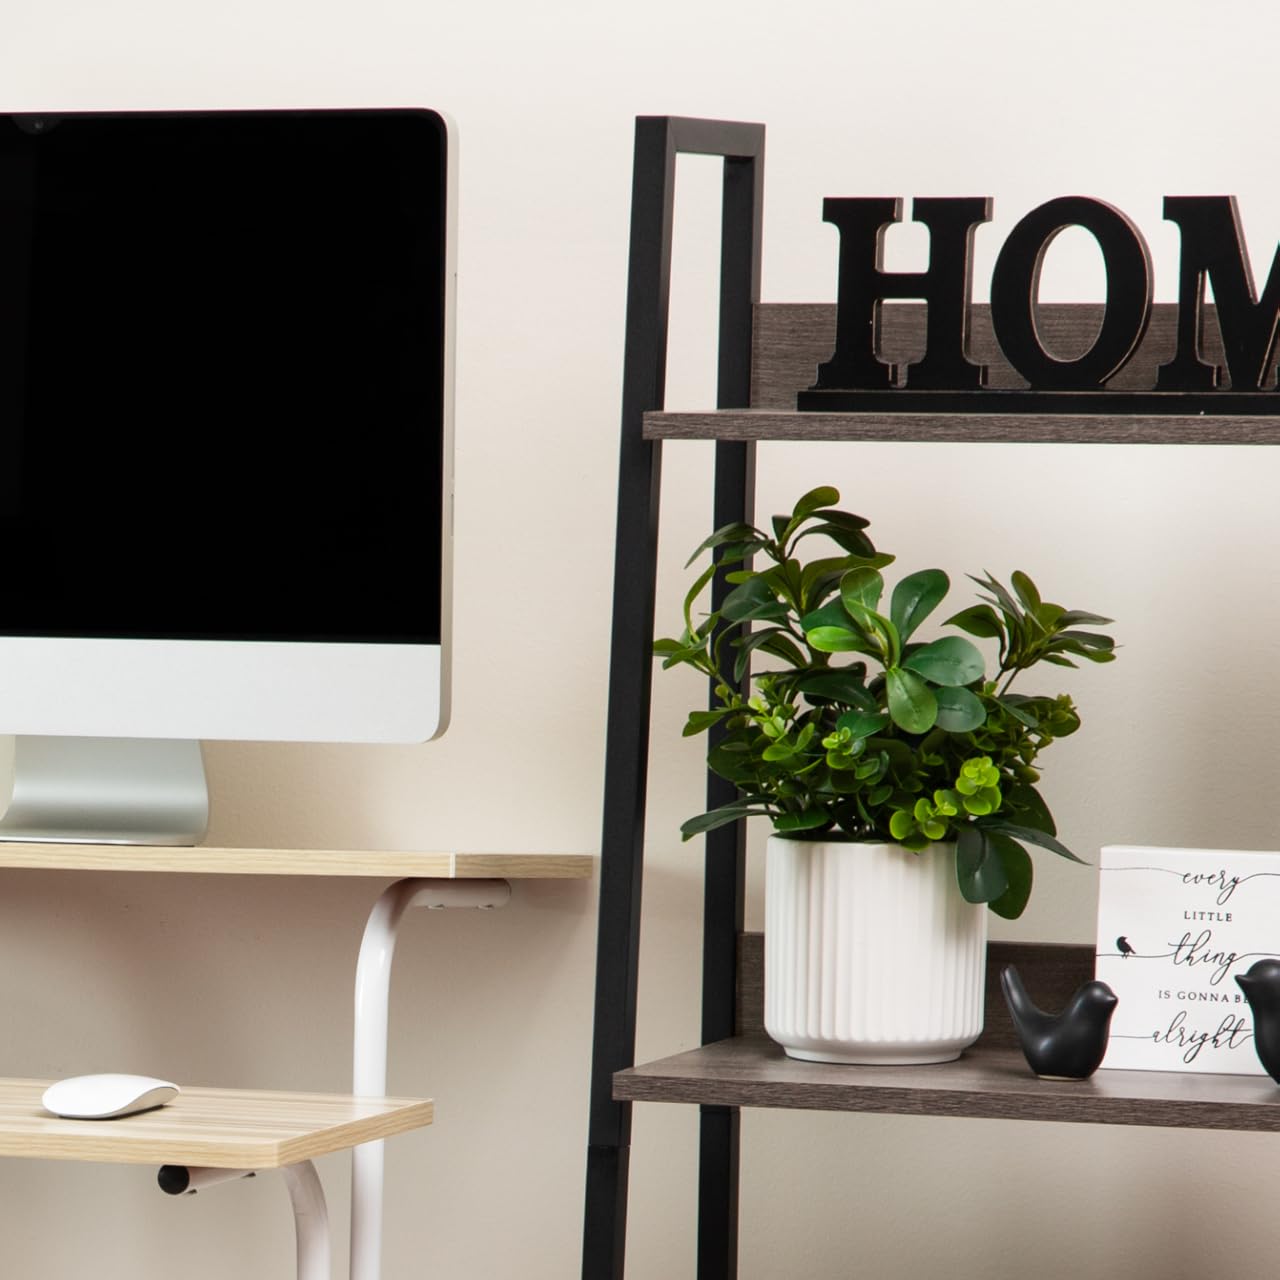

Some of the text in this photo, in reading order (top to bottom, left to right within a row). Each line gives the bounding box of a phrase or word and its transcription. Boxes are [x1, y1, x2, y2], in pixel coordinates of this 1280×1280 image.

[1182, 869, 1240, 905] every
[1183, 910, 1233, 922] LITTLE
[1167, 929, 1238, 986] thing
[1158, 990, 1171, 999] IS
[1177, 991, 1229, 1003] GONNA
[1152, 1010, 1253, 1064] alright
